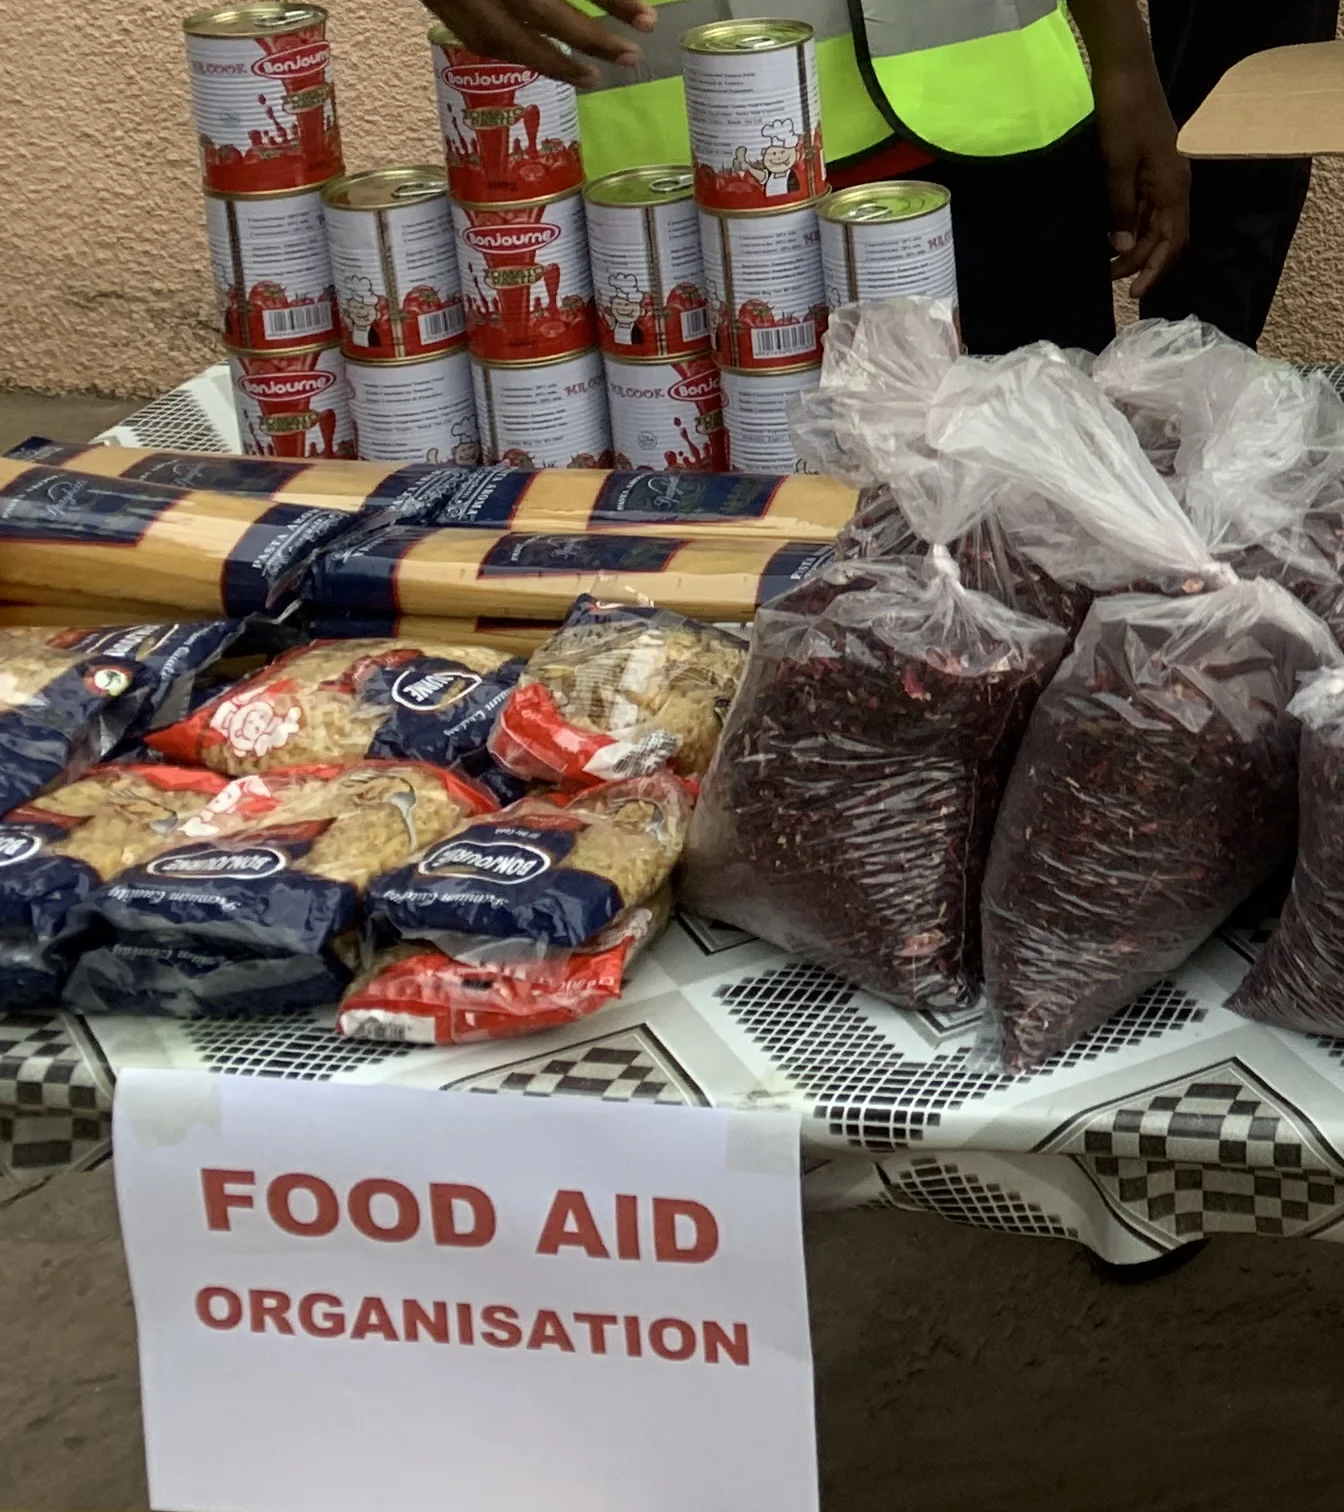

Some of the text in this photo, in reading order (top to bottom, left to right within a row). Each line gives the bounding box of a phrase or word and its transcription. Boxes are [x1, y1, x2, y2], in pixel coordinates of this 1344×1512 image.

[164, 855, 273, 873] BONJOURNE
[431, 848, 539, 876] BONJOURNE
[200, 1167, 719, 1265] FOOD AID
[195, 1286, 750, 1367] ORGANISATION
